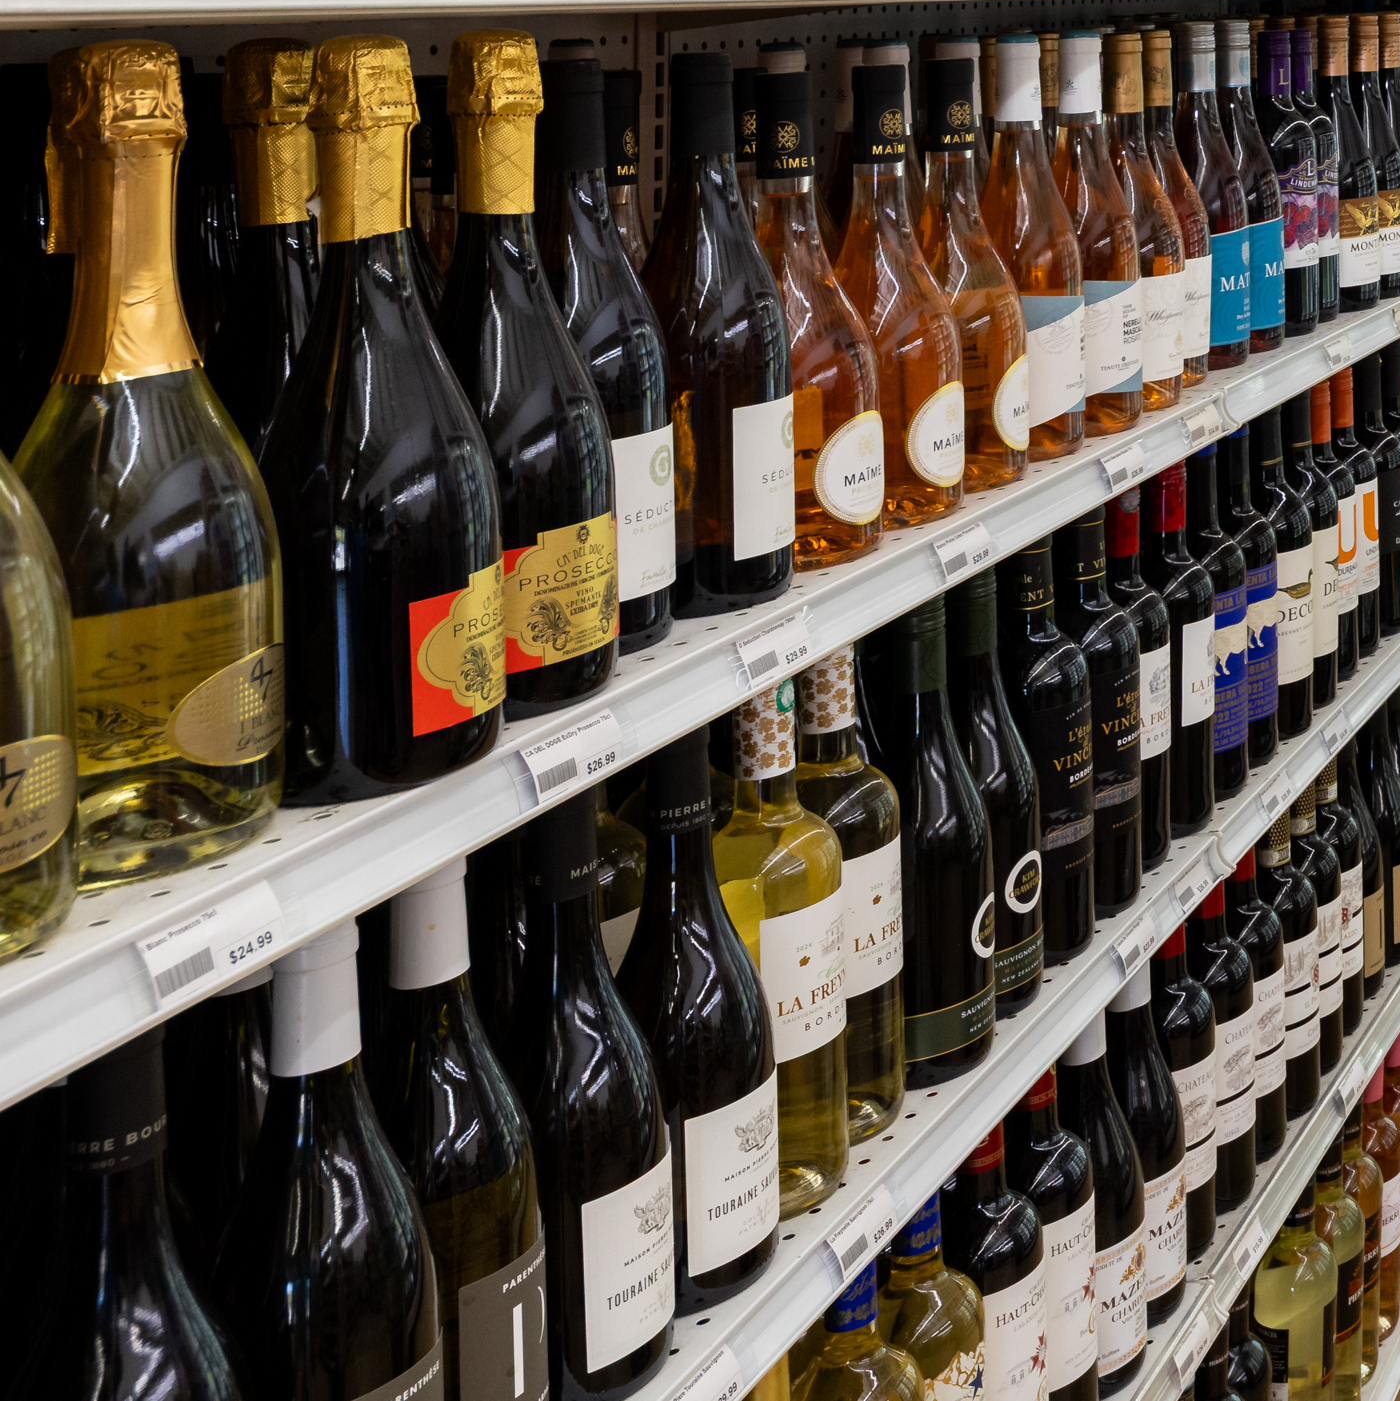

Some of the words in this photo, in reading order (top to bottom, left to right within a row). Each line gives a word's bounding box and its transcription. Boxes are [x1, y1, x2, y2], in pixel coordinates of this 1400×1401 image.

[844, 463, 882, 487] MAÏME
[519, 548, 618, 591] PROSECCO
[566, 591, 601, 609] SPUMANTE
[576, 586, 594, 598] VINO
[742, 631, 761, 647] Seduction
[761, 621, 785, 637] Chardonnay
[785, 646, 808, 664] $29.99
[577, 718, 601, 736] Prosecco
[587, 751, 616, 776] $26.99
[1022, 869, 1035, 882] KIM
[168, 917, 200, 941] Prosecco
[228, 930, 274, 966] $24.99
[796, 942, 812, 953] 2024
[1002, 974, 1016, 984] NEW
[1018, 960, 1039, 977] ZEALAND
[777, 996, 803, 1017] LA
[708, 1189, 759, 1221] TOURAINE
[849, 1204, 868, 1224] Sauvignon
[873, 1218, 893, 1243] $26.99
